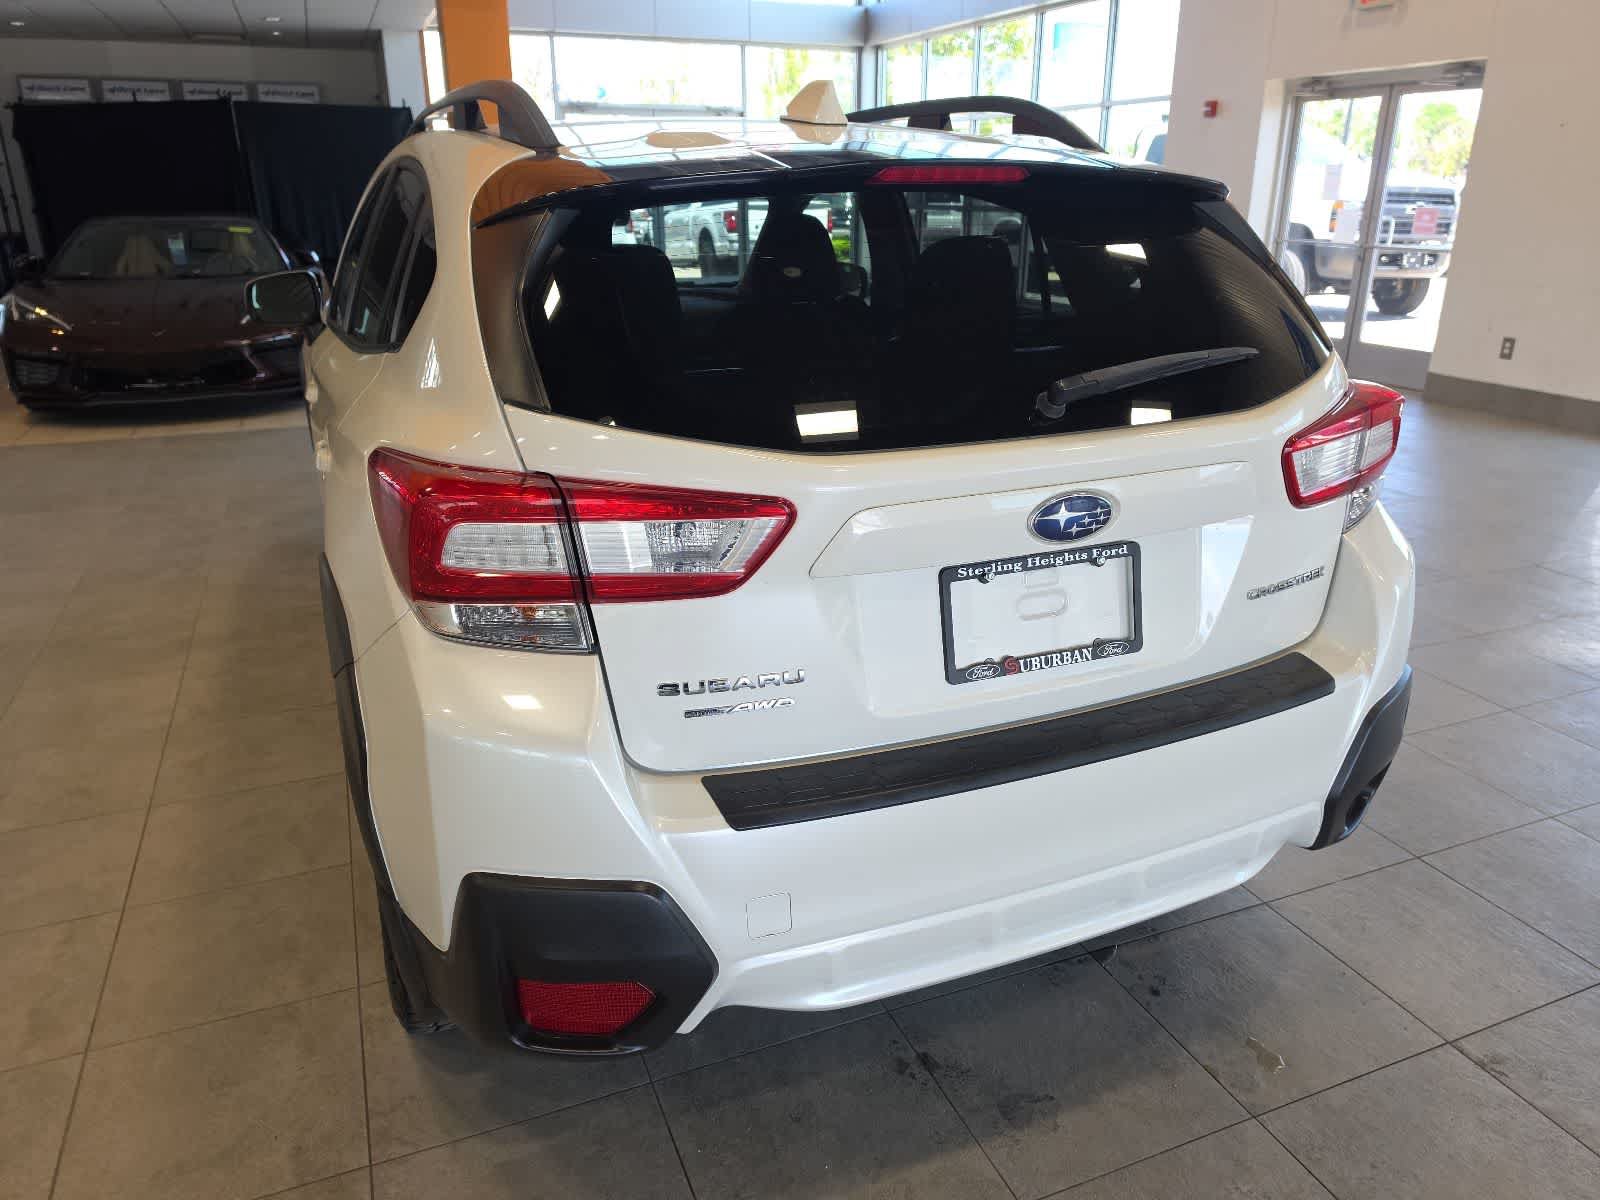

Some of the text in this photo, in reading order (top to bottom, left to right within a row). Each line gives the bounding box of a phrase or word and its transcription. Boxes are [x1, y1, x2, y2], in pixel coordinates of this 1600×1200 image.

[957, 545, 1129, 578] Sterling Heights Ford
[971, 643, 1126, 680] Ford SUBURBAN Ford
[656, 669, 806, 696] SUBARU
[726, 697, 796, 714] AWD
